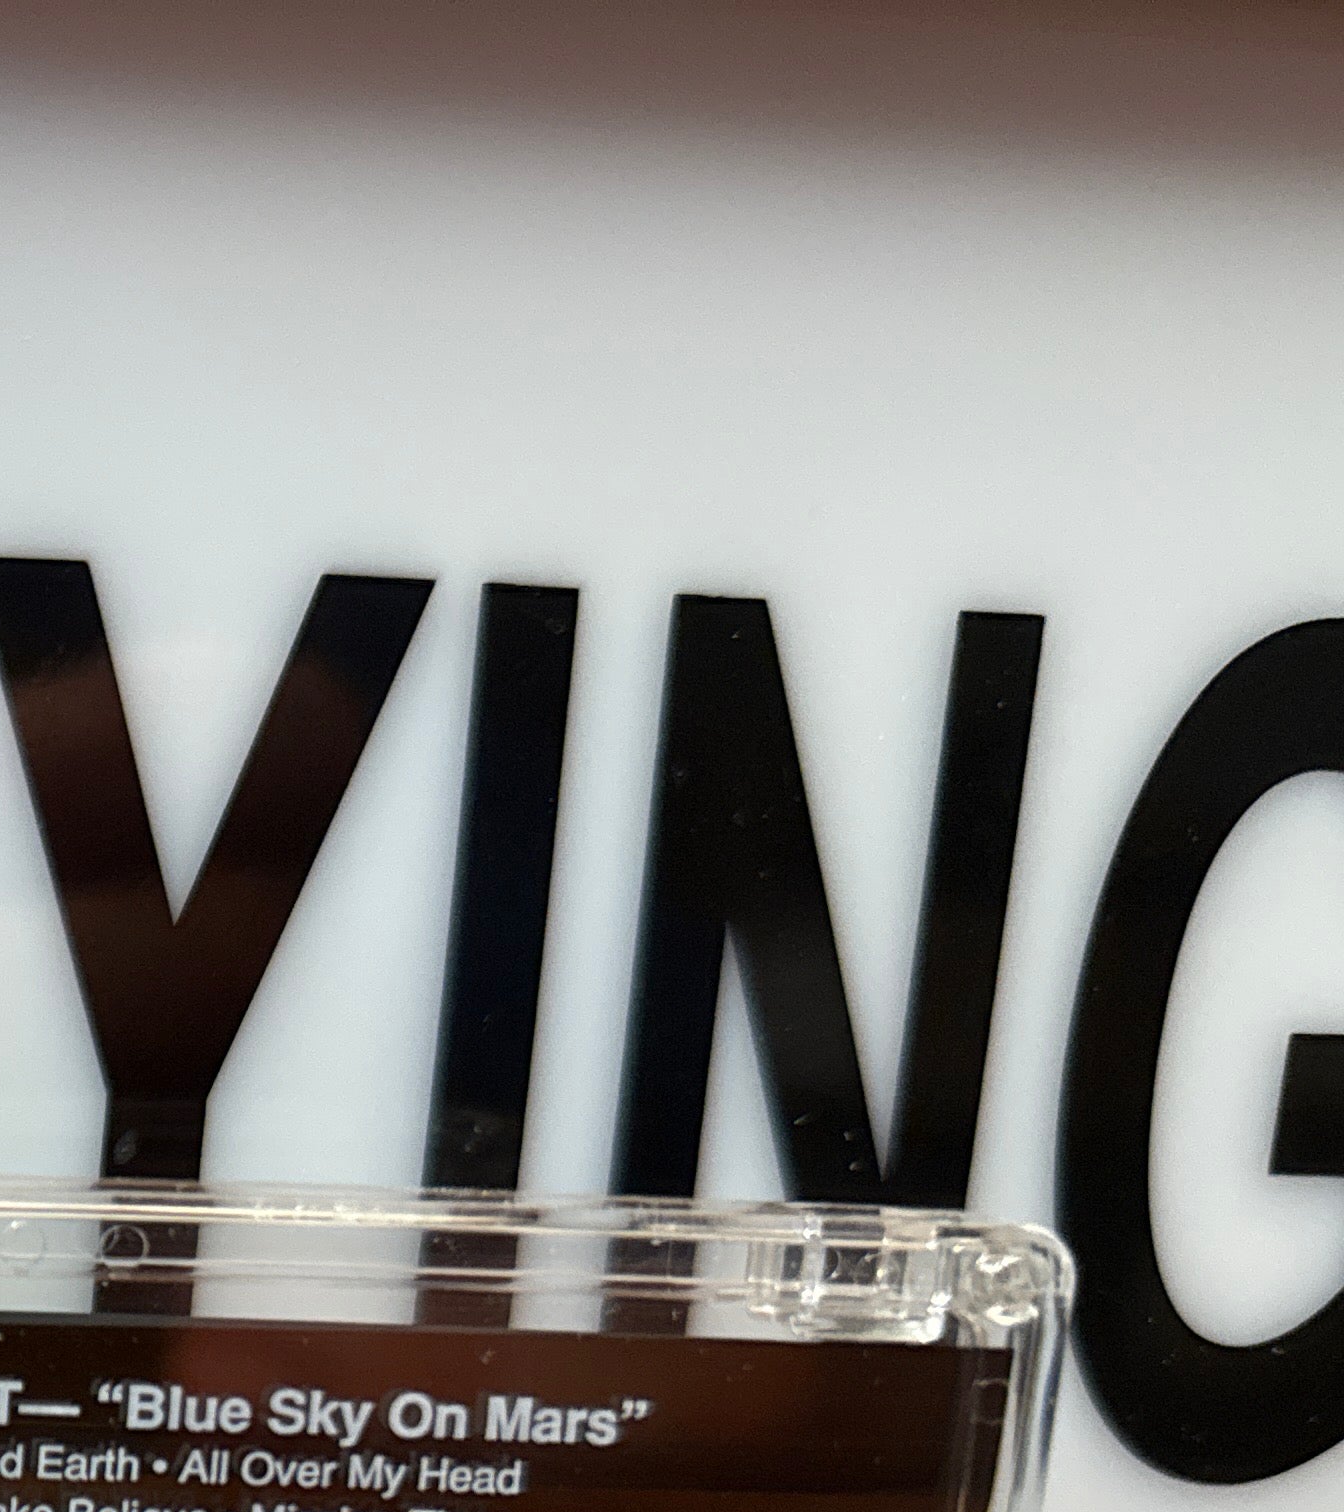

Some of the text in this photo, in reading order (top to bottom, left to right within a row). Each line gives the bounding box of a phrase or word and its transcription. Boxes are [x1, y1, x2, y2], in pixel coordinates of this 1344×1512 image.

[97, 1382, 252, 1432] “Blue
[266, 1388, 372, 1447] Sky
[388, 1392, 468, 1440] On
[483, 1396, 650, 1446] Mars”
[37, 1444, 140, 1482] Earth
[178, 1450, 229, 1486] All
[241, 1451, 338, 1488] Over
[347, 1455, 407, 1499] My
[418, 1456, 524, 1495] Head
